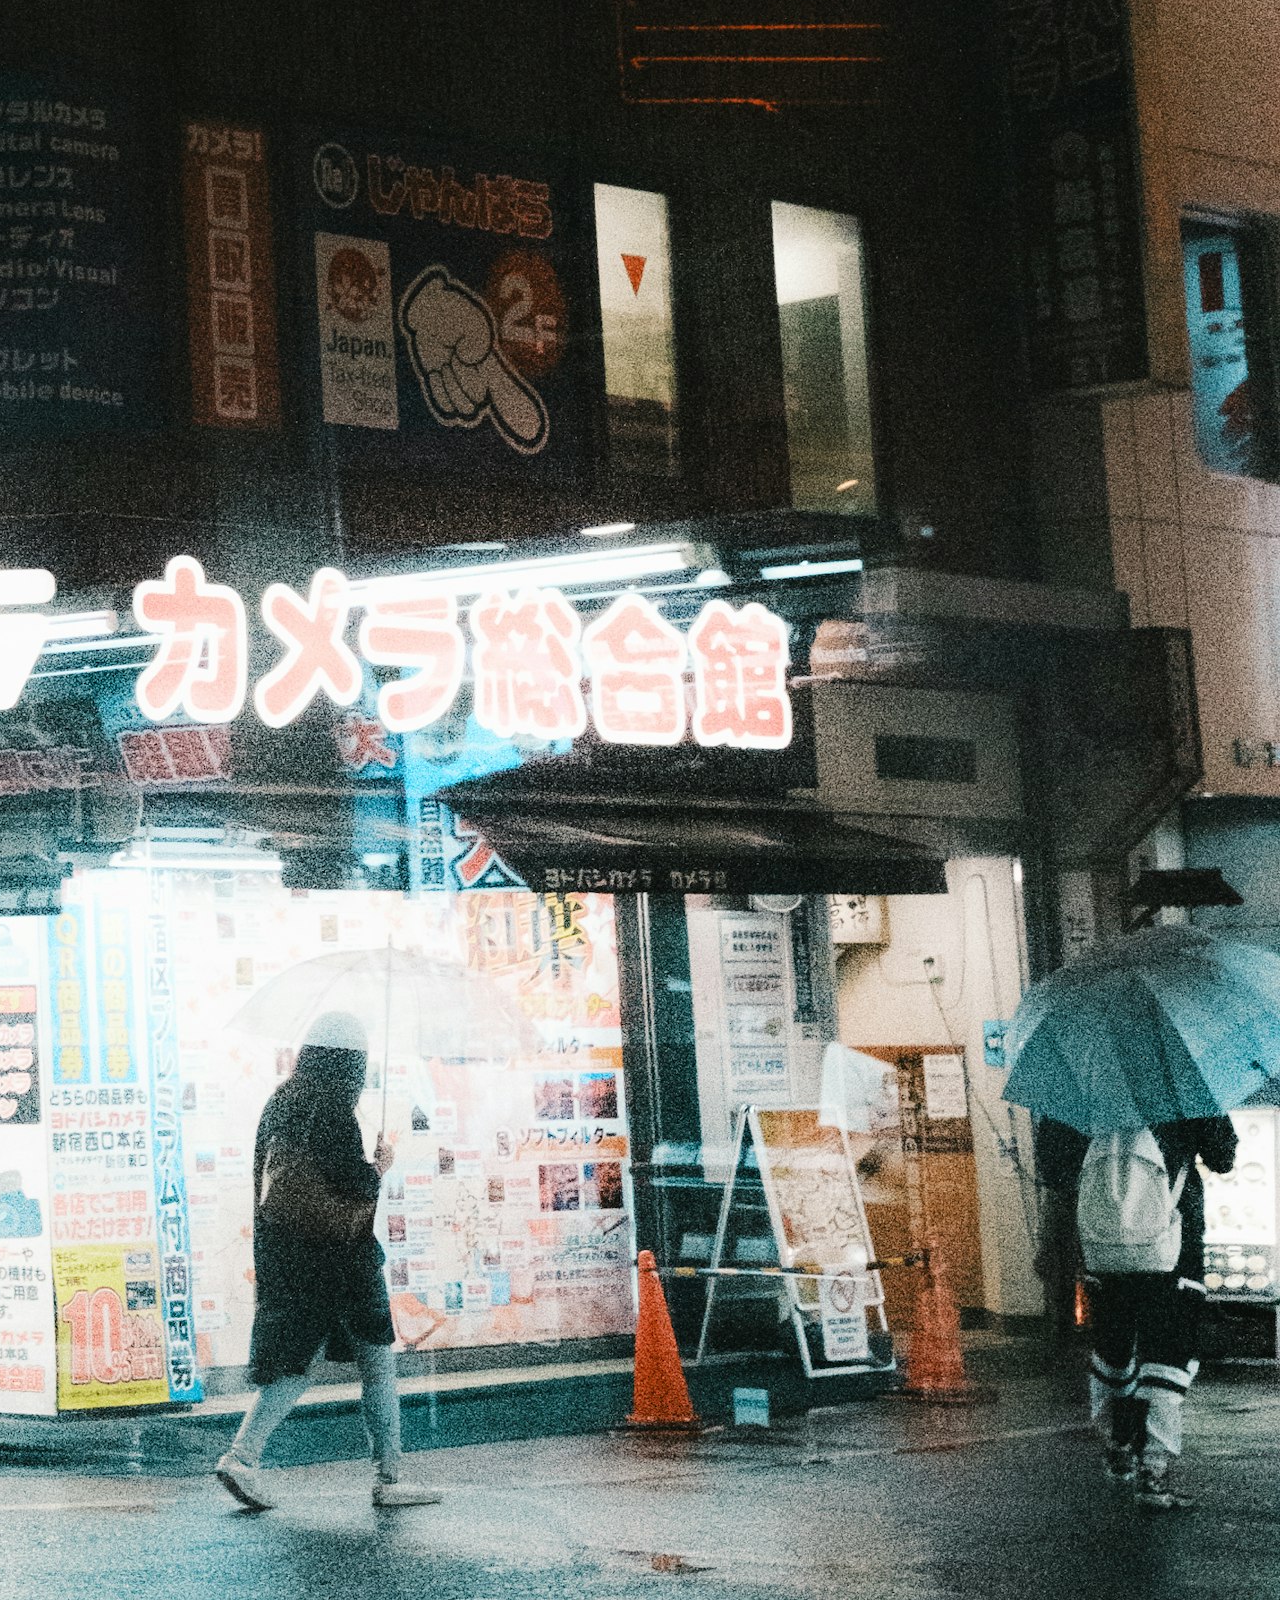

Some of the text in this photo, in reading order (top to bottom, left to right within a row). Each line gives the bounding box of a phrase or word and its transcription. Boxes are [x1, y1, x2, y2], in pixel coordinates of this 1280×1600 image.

[47, 134, 121, 162] camera
[61, 200, 107, 225] Lens
[58, 381, 124, 408] device
[132, 552, 798, 750] カメラ総合館
[48, 1086, 148, 1107] どちらの商品券も
[50, 1110, 148, 1129] ヨドバシカメラ
[51, 1130, 148, 1153] 新宿西口本店
[518, 1126, 619, 1146] ソフトフィルター
[52, 1189, 149, 1216] 各店でご利用
[52, 1216, 154, 1242] いただけます!
